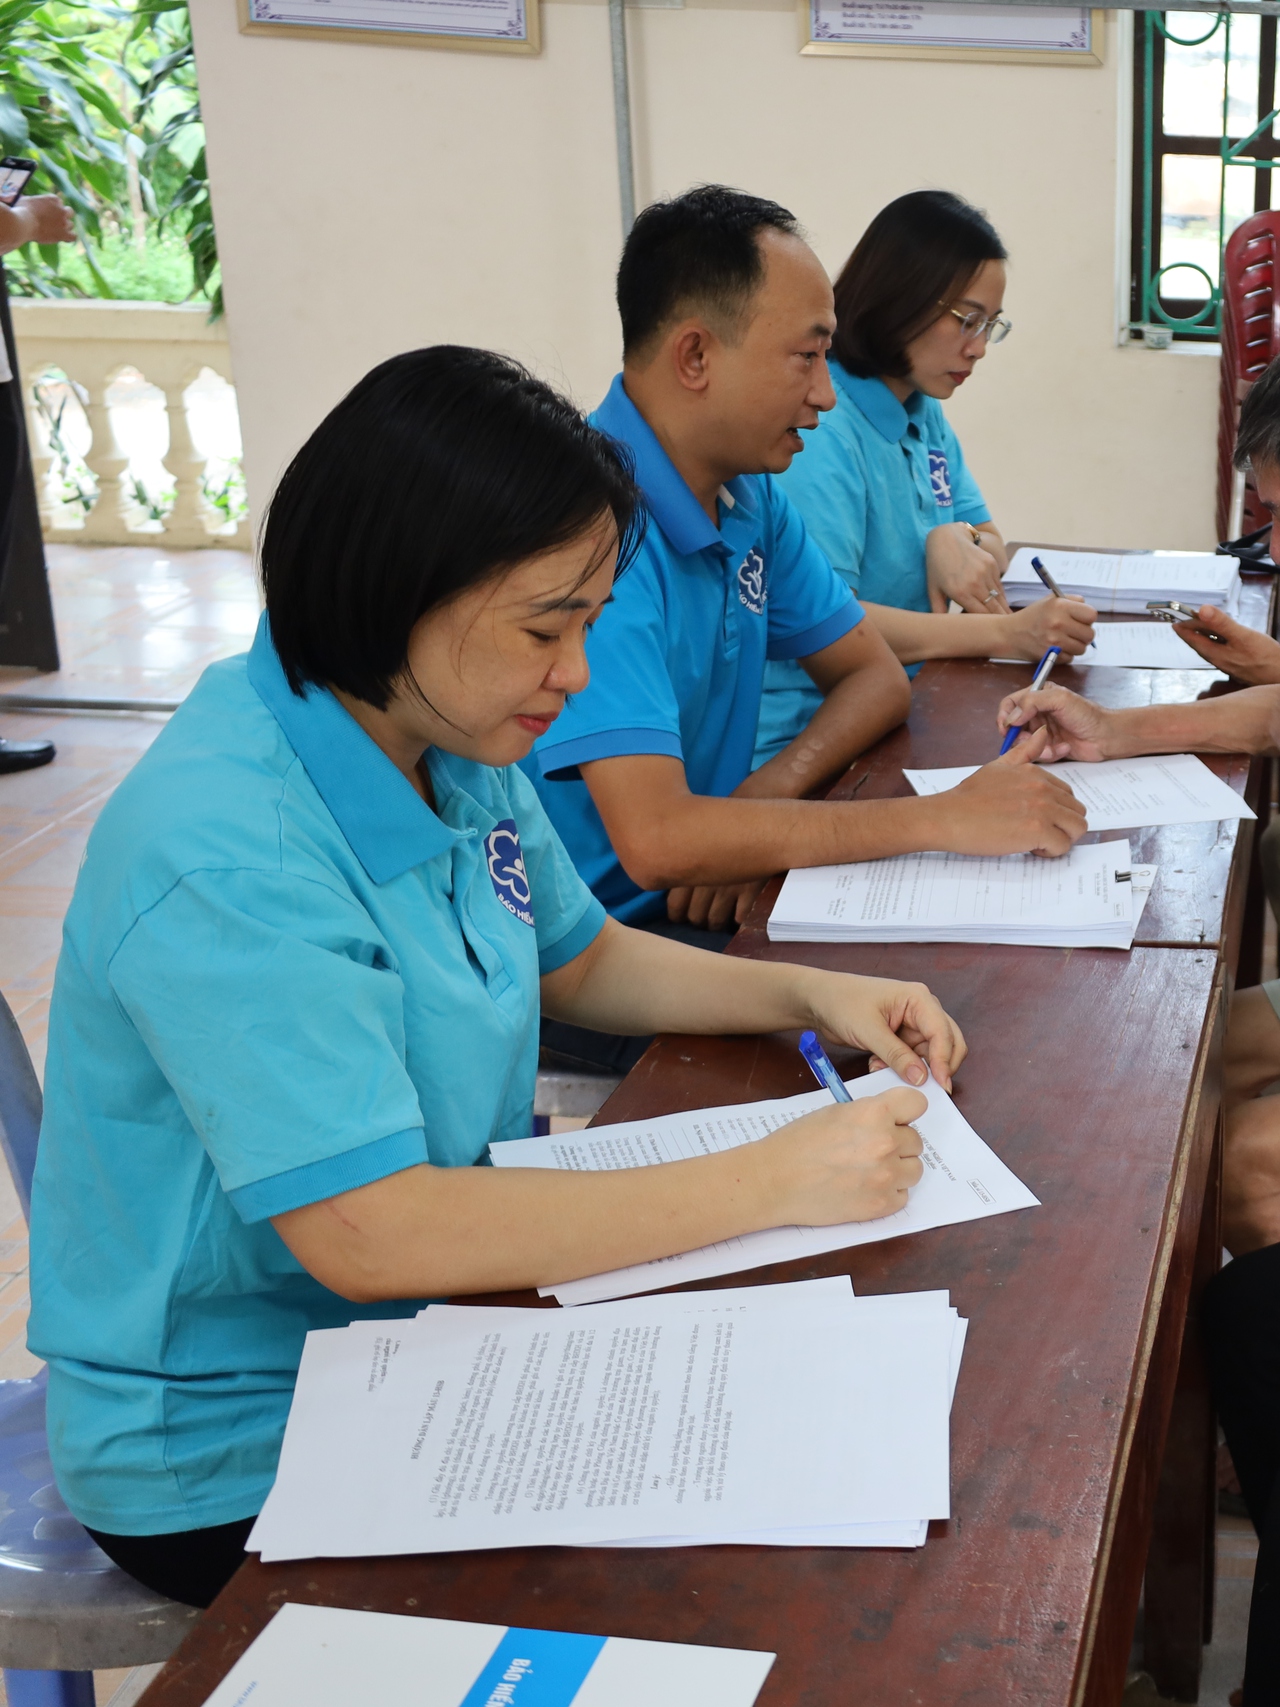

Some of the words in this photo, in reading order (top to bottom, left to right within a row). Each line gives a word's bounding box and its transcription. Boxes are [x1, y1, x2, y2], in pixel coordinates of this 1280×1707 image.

[411, 1438, 424, 1459] HƯỚNG
[418, 1424, 428, 1436] DẪN
[423, 1412, 433, 1423] LẬP
[502, 1658, 534, 1682] BẢO
